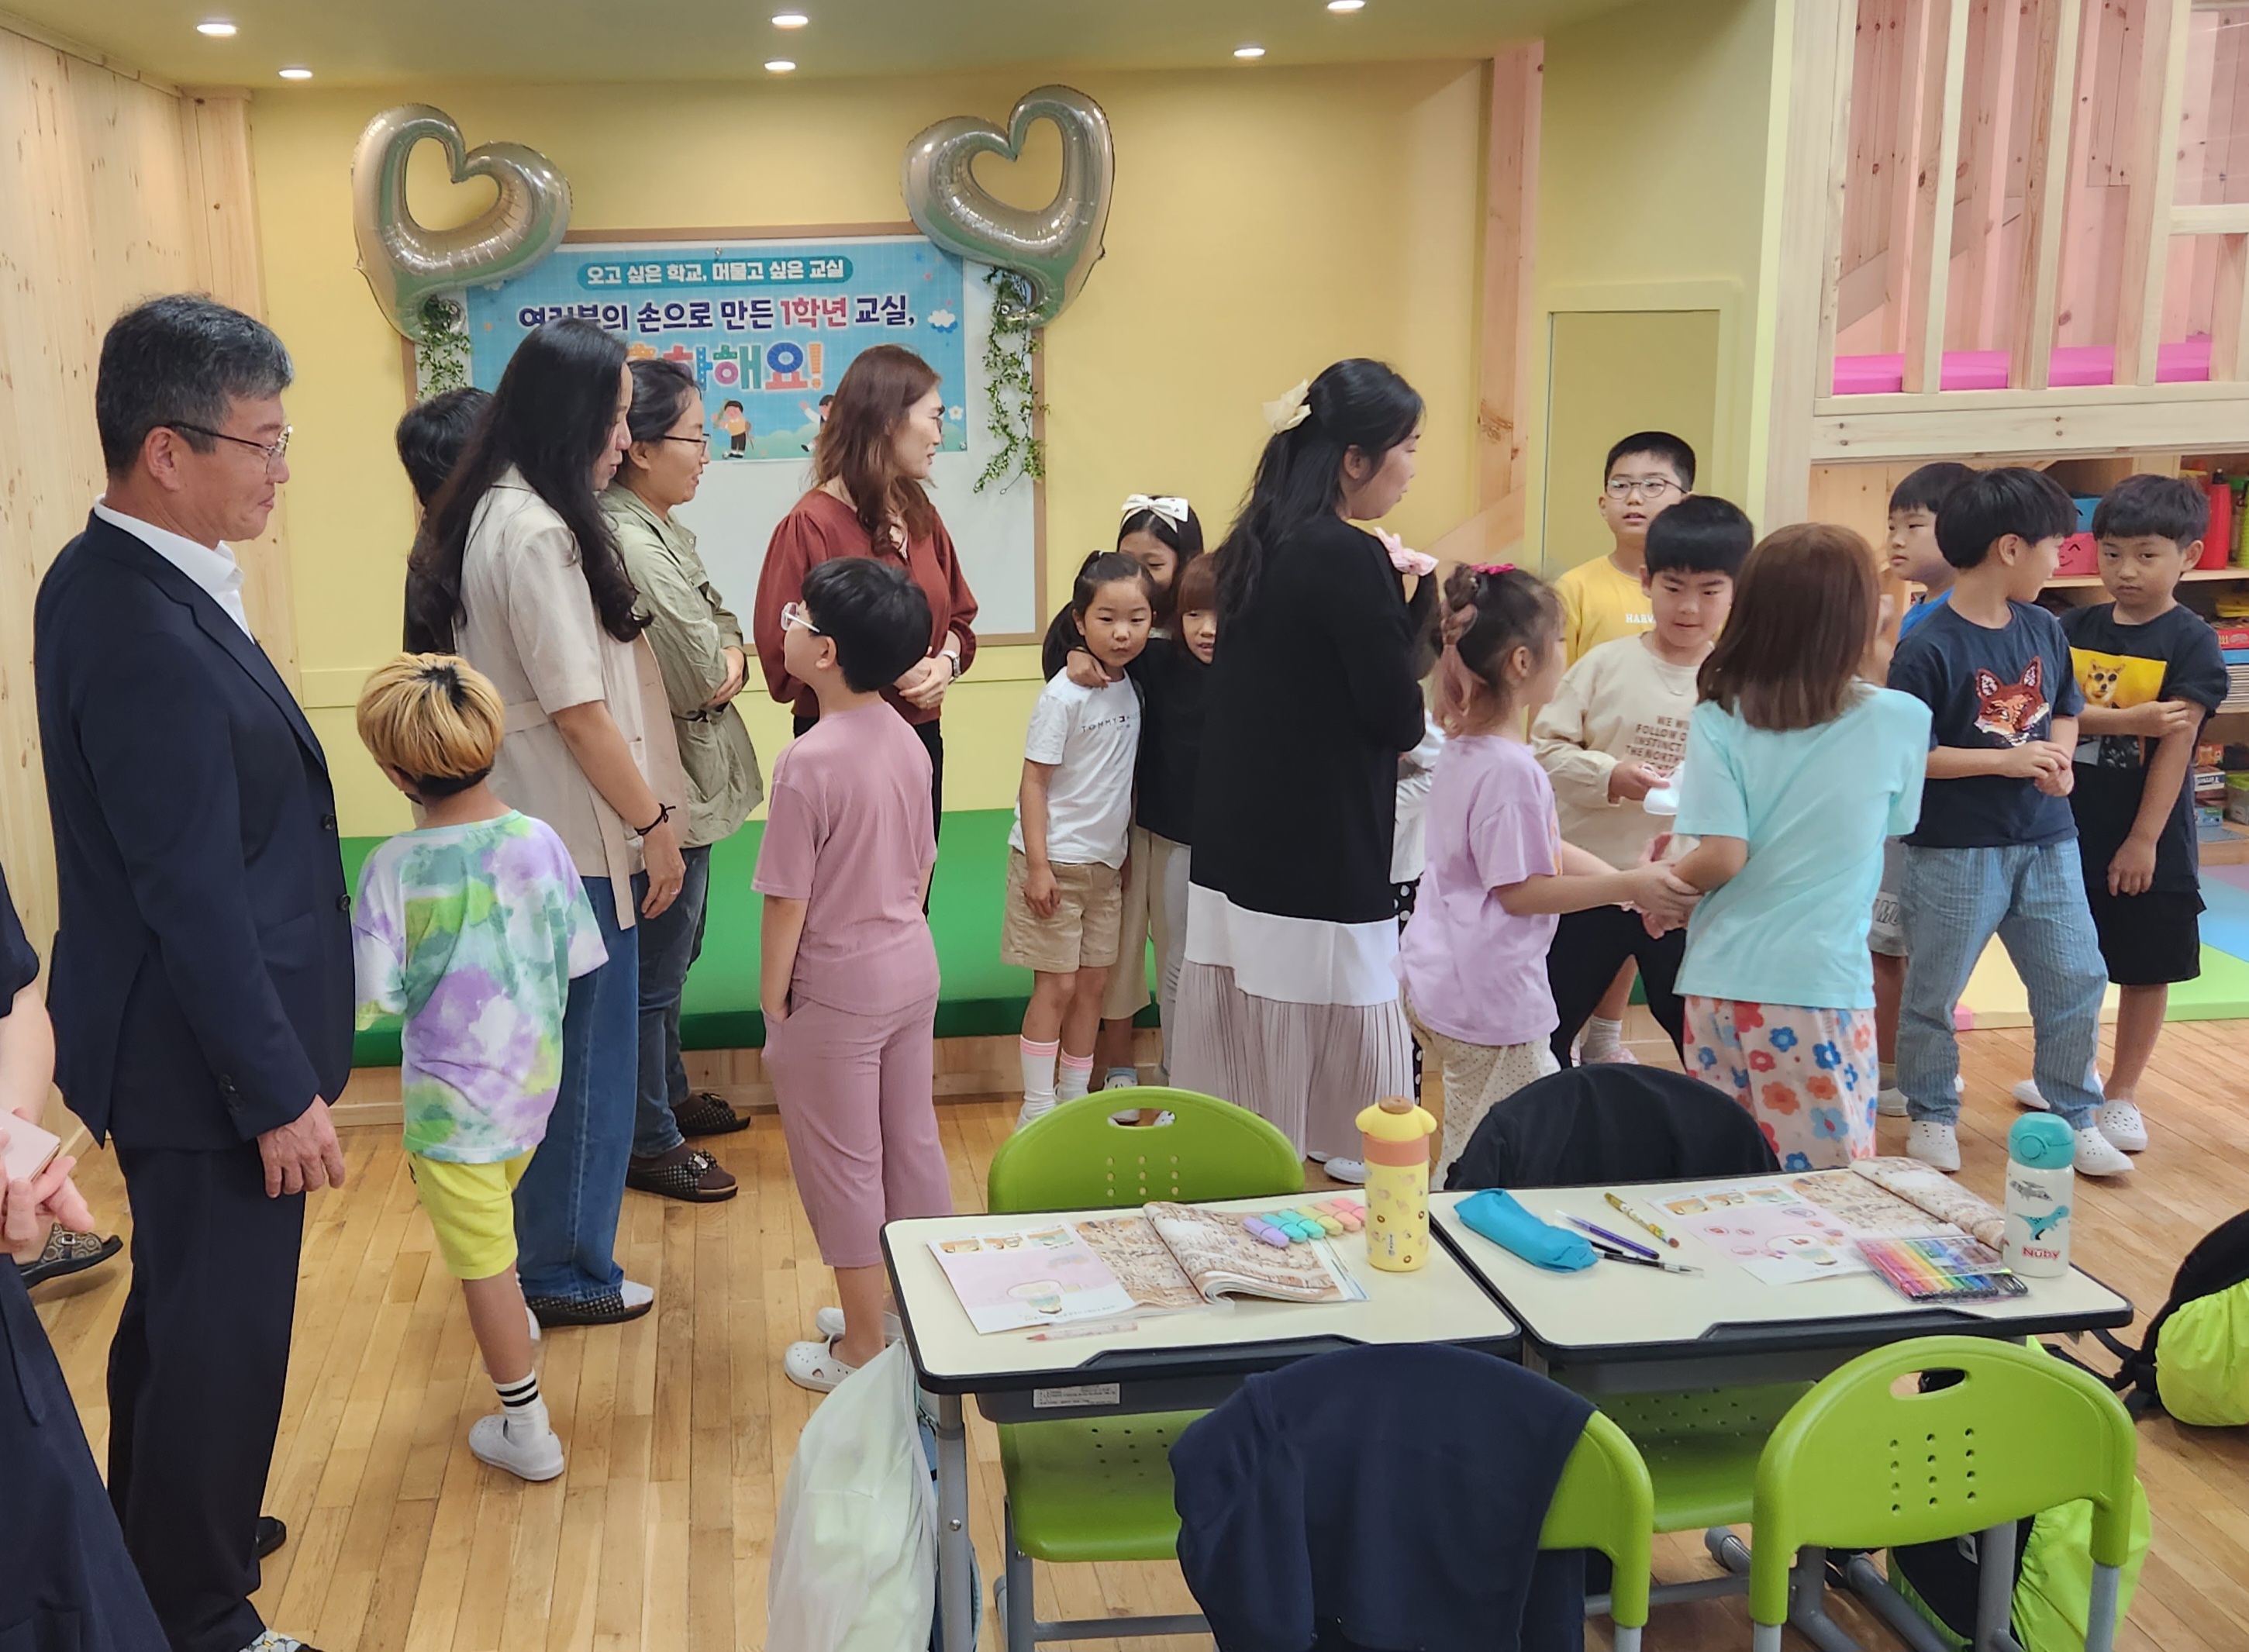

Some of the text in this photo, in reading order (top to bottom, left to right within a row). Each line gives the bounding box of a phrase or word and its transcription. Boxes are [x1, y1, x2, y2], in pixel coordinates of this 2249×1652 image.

[587, 258, 844, 284] 오고 싶은 학교, 머물고 싶은 교실
[636, 302, 713, 333] 손으로
[720, 299, 774, 330] 만든
[780, 297, 847, 329] 1학년
[855, 295, 915, 326] 교실,
[627, 342, 822, 391] 하해요!
[1081, 717, 1117, 733] TOMMY
[1635, 723, 1678, 739] FOLLOW
[1626, 744, 1685, 764] THE NORTH
[1634, 736, 1682, 752] INSTINCT
